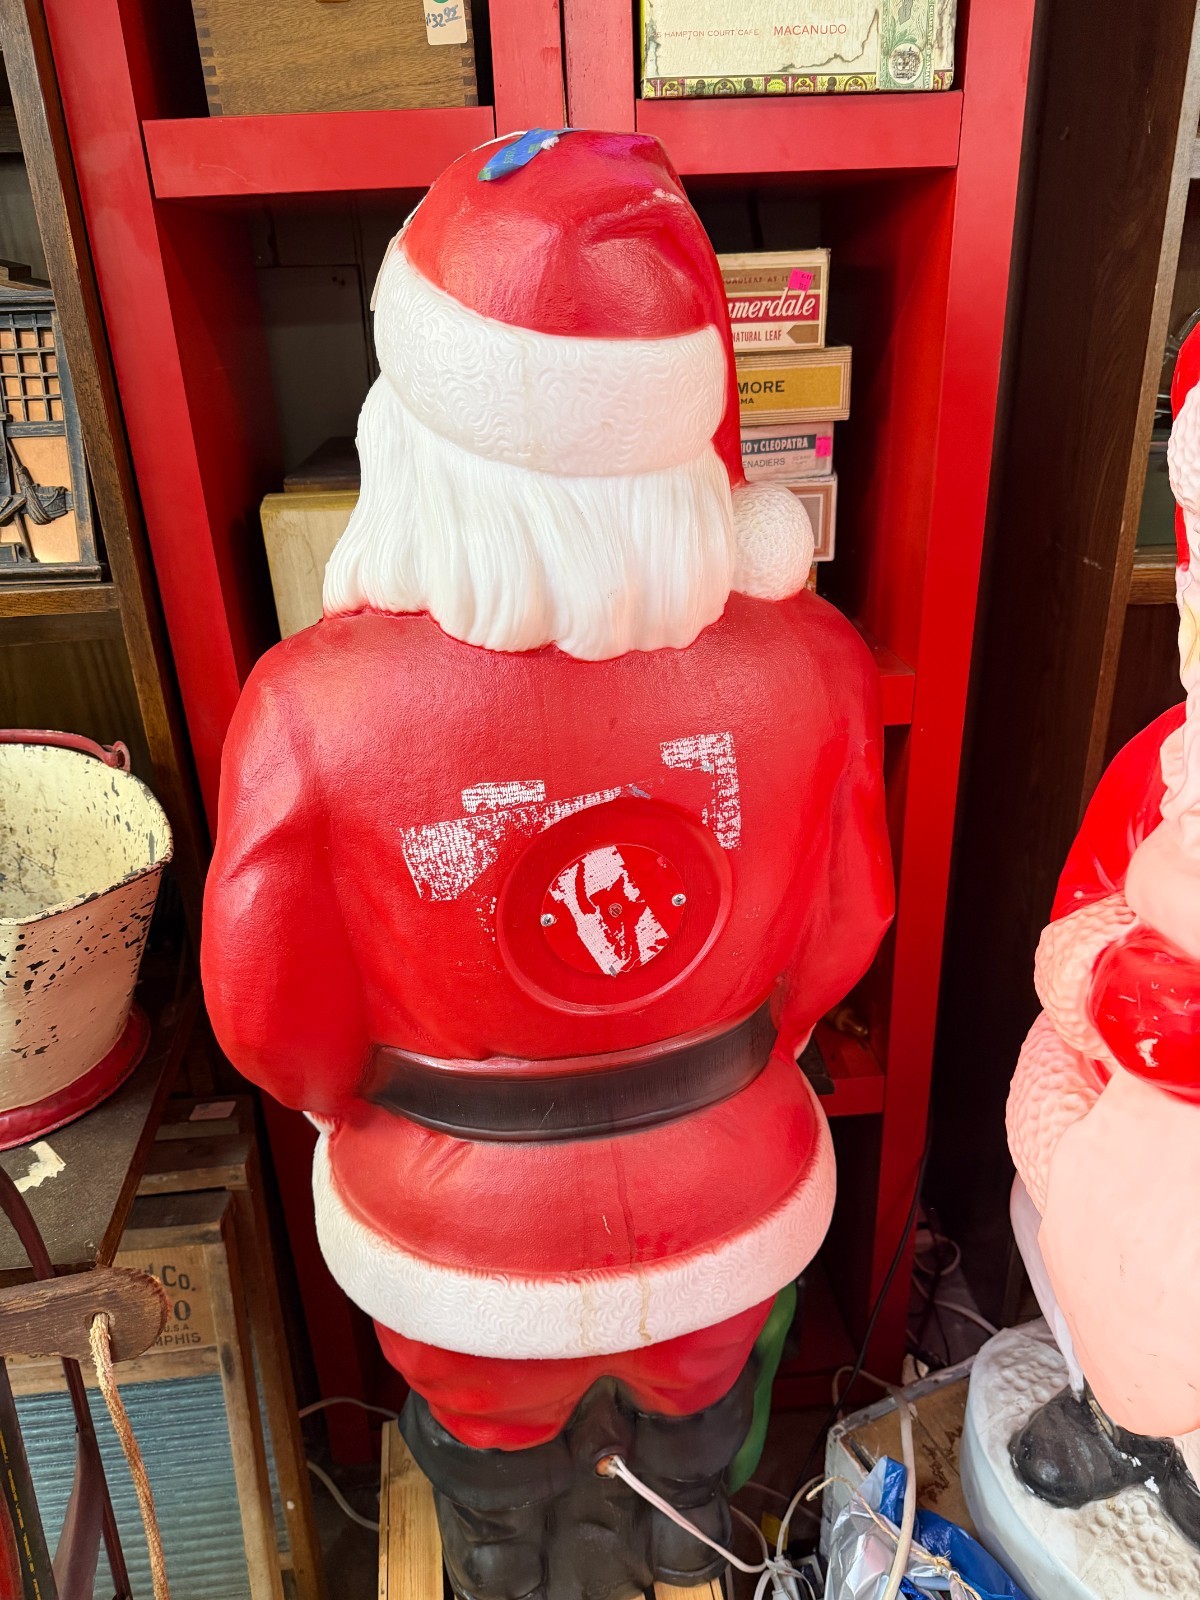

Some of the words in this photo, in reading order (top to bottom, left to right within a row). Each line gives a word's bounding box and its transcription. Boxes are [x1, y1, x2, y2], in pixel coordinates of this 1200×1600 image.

[664, 30, 705, 38] HAMPTON
[707, 29, 736, 37] COURT
[773, 24, 848, 36] MACANUDO
[765, 329, 782, 341] LEAF
[760, 437, 808, 451] CLEOPATRA
[162, 1265, 196, 1291] Co.
